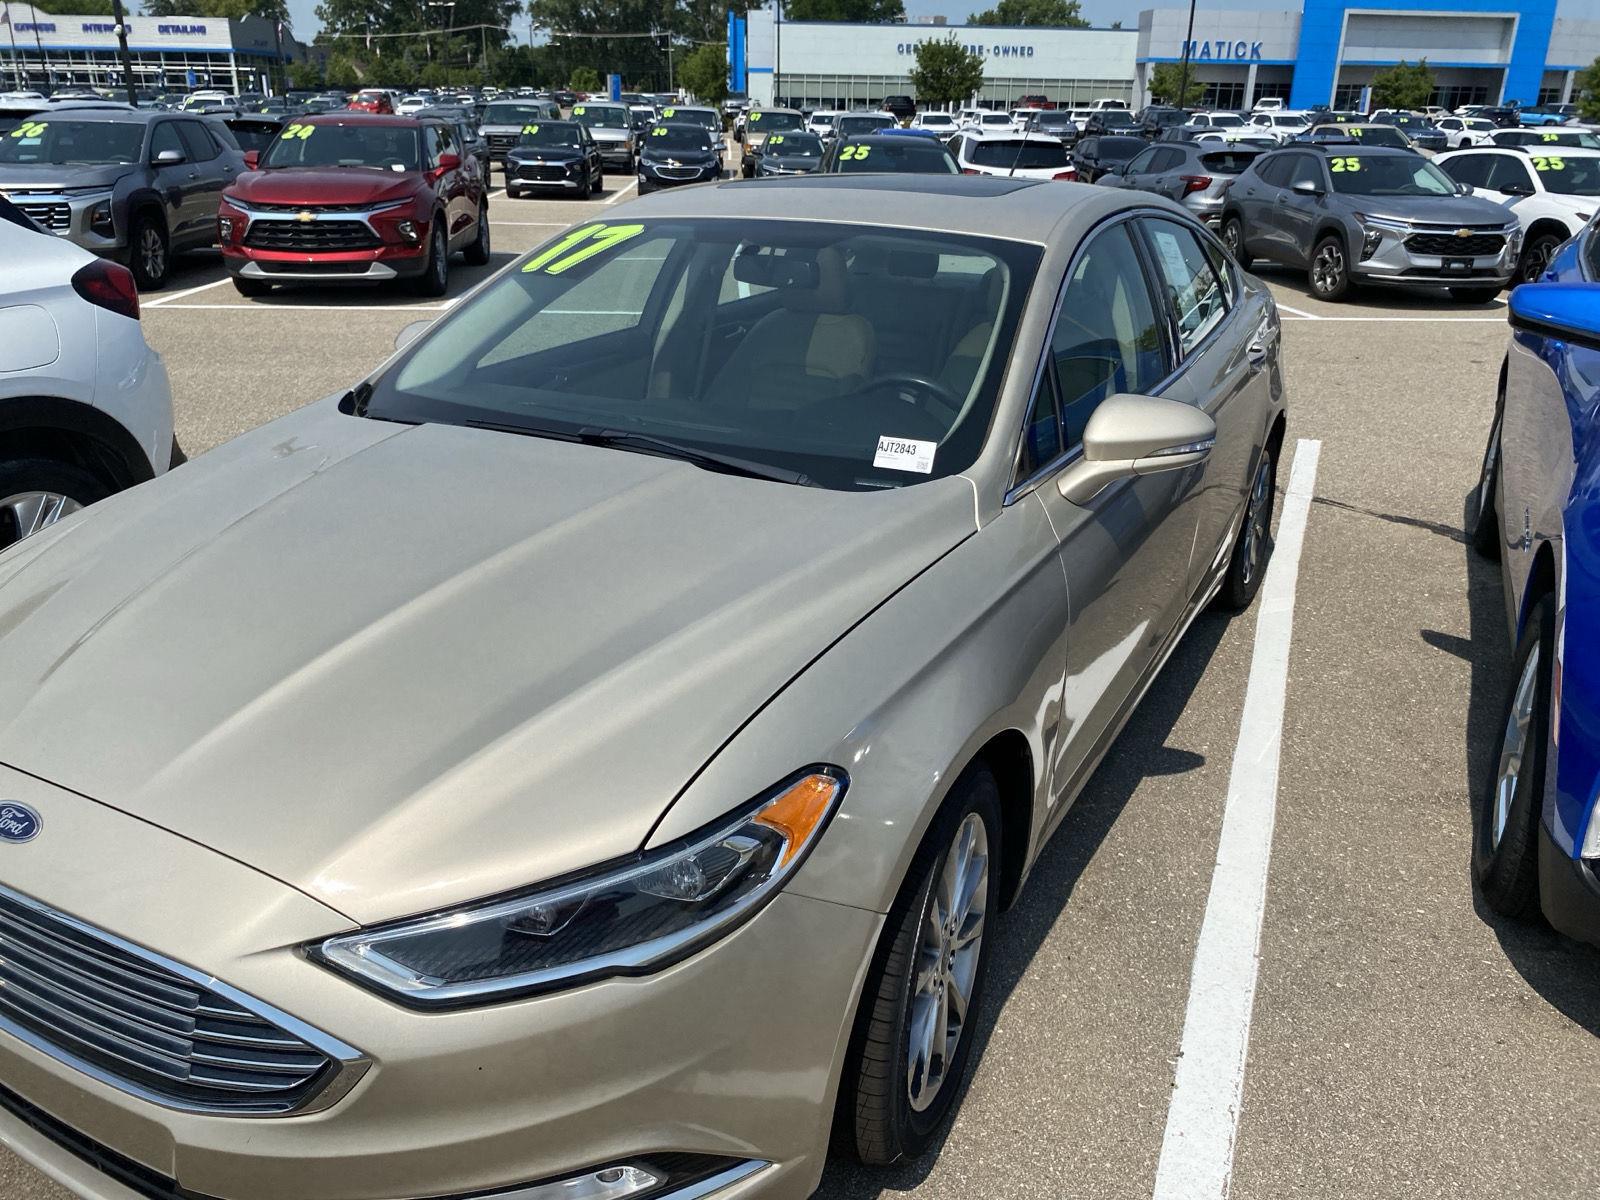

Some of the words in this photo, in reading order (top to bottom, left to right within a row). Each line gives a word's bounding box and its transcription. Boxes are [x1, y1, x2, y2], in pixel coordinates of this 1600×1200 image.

[158, 24, 207, 34] DETAILING
[1181, 40, 1263, 60] MATICK
[11, 122, 49, 137] 26
[281, 124, 315, 139] 24
[839, 145, 871, 160] 25
[1331, 158, 1361, 172] 25
[1532, 157, 1566, 171] 25
[521, 224, 646, 275] 17
[877, 441, 917, 456] AJT2843
[0, 808, 30, 835] Ford
